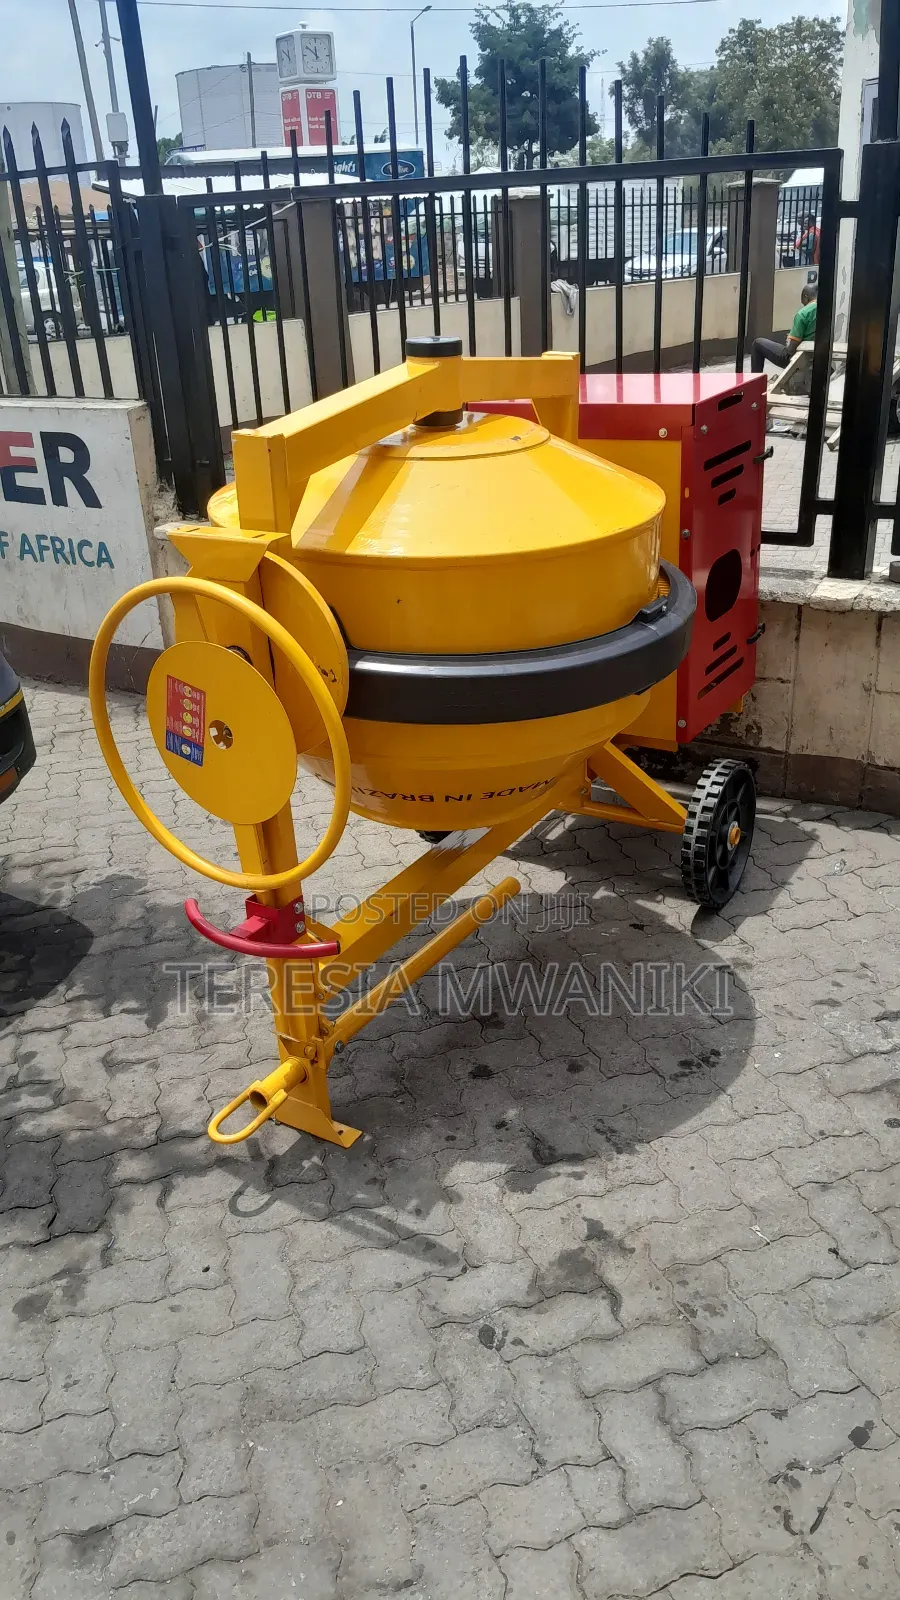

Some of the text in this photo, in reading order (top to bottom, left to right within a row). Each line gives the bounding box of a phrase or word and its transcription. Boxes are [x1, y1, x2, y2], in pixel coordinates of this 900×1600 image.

[306, 91, 322, 99] DTB
[333, 160, 356, 173] ights
[20, 532, 115, 569] AFRICA
[480, 776, 556, 800] MADE
[445, 793, 472, 802] IN
